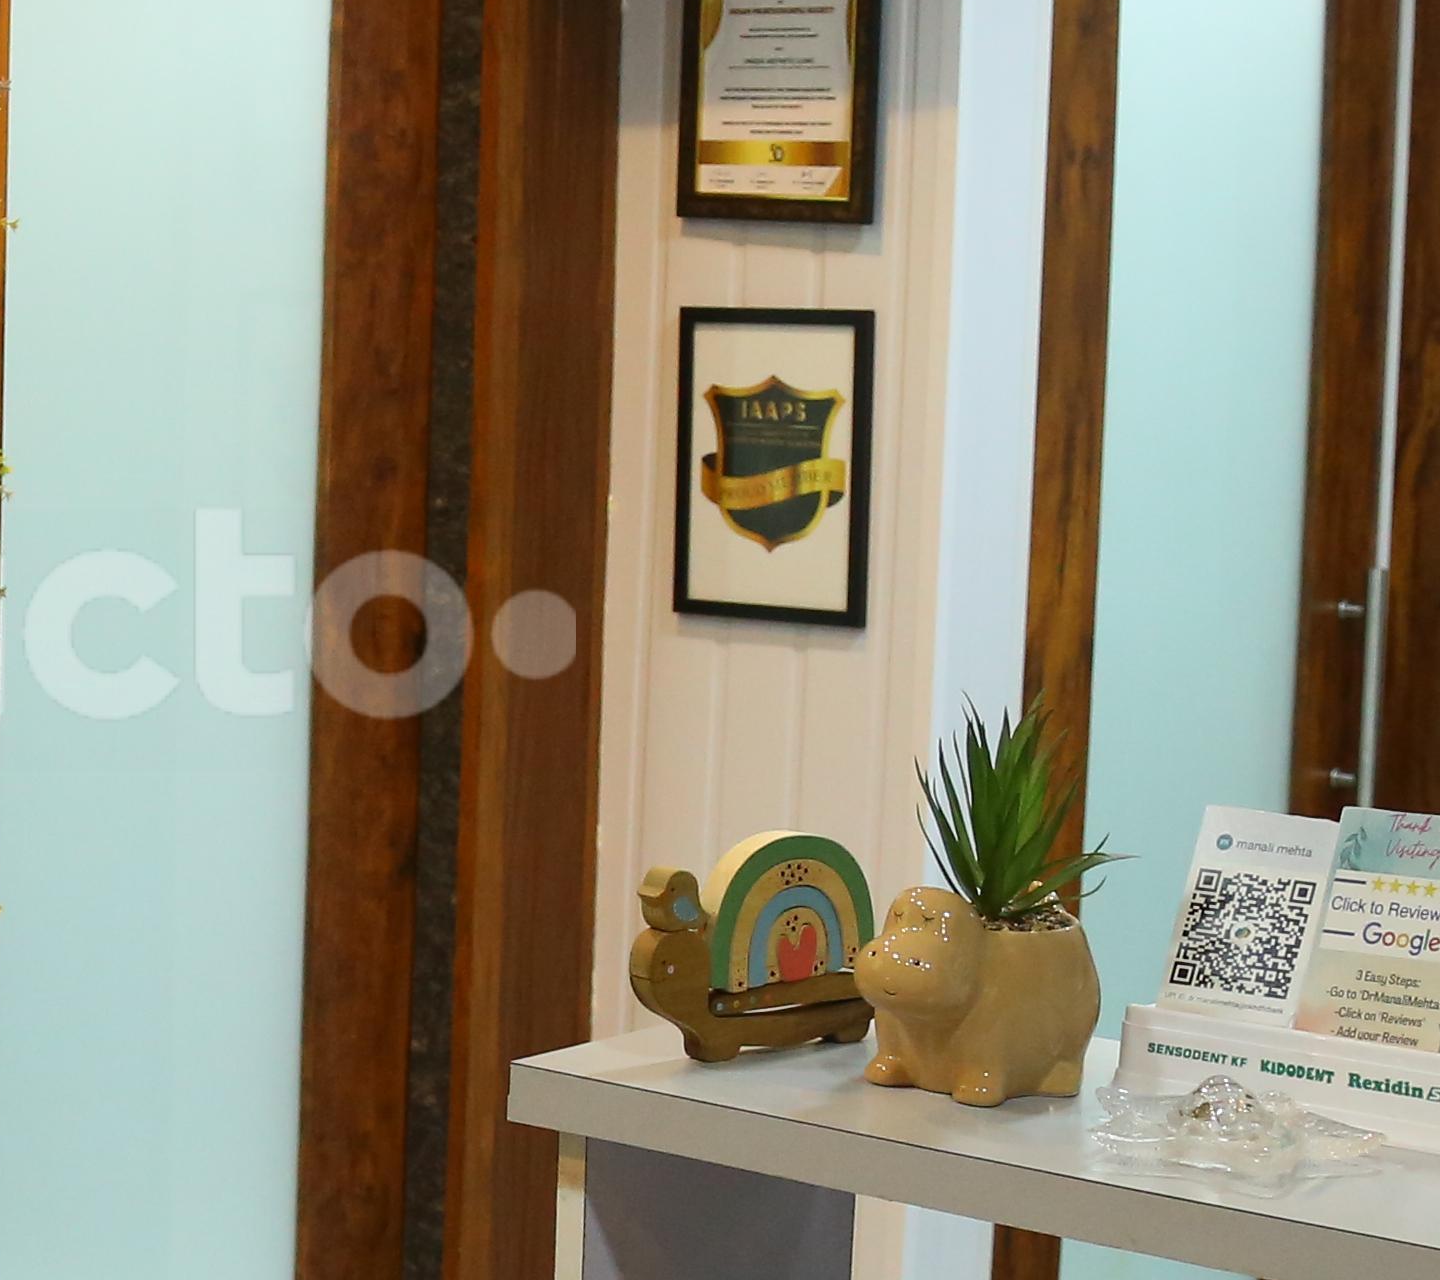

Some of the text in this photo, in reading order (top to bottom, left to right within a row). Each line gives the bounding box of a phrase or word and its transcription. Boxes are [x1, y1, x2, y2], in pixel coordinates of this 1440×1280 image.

[1389, 813, 1433, 835] Thank
[1236, 839, 1313, 858] manali mehta
[1331, 895, 1367, 914] Click
[1370, 901, 1384, 916] to
[1362, 921, 1440, 956] Google
[1355, 969, 1363, 981] 3
[1364, 970, 1388, 986] Easy
[1346, 989, 1357, 1000] to
[1364, 1011, 1377, 1022] on
[1336, 1025, 1358, 1038] Add
[1383, 1031, 1420, 1047] Review
[1147, 1042, 1228, 1065] SENSODENT
[1231, 1056, 1248, 1068] KF
[1260, 1059, 1335, 1084] KIDODENT
[1348, 1072, 1425, 1099] Rexidin
